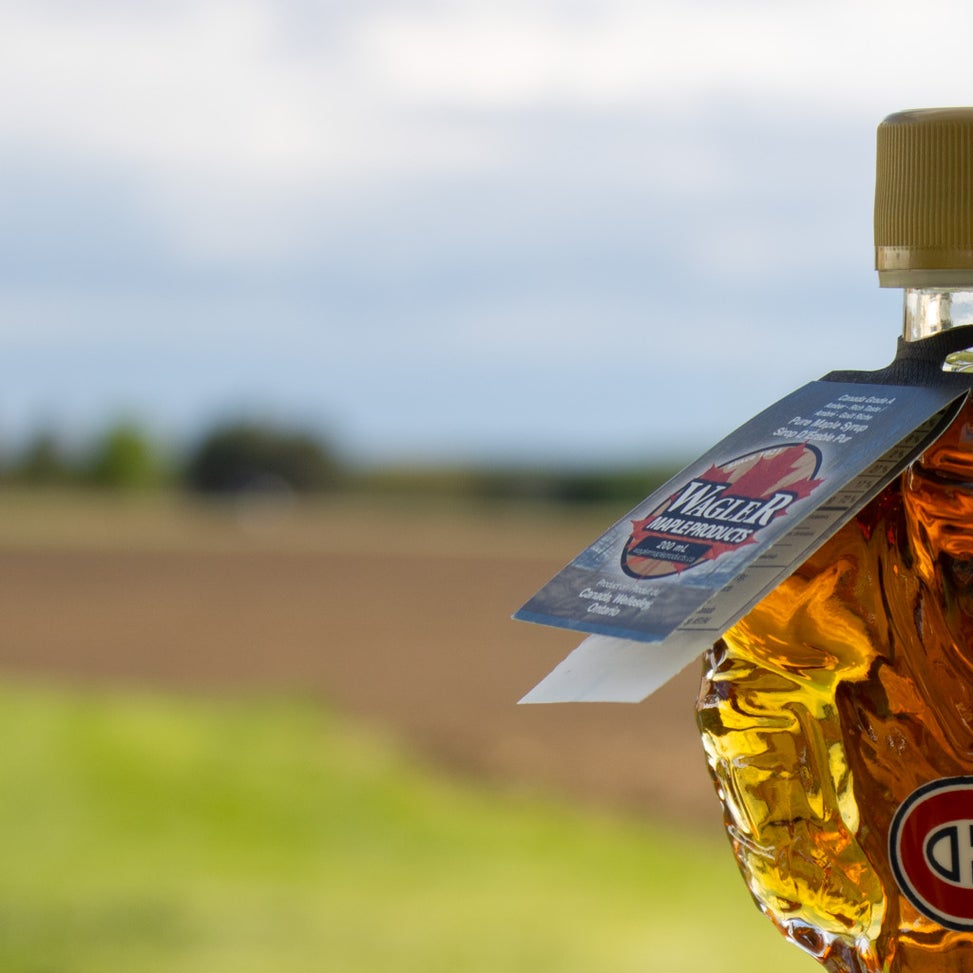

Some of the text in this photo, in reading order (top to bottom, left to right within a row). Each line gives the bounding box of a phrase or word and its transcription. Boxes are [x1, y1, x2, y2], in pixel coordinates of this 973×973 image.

[788, 416, 870, 434] Pure Maple Syrup
[772, 426, 799, 439] Sirop
[832, 433, 854, 444] Pur
[645, 516, 754, 543] MAPLE PRODUCTS
[656, 540, 690, 553] 200 mL
[578, 587, 613, 604] Canada,
[586, 602, 621, 617] Ontario
